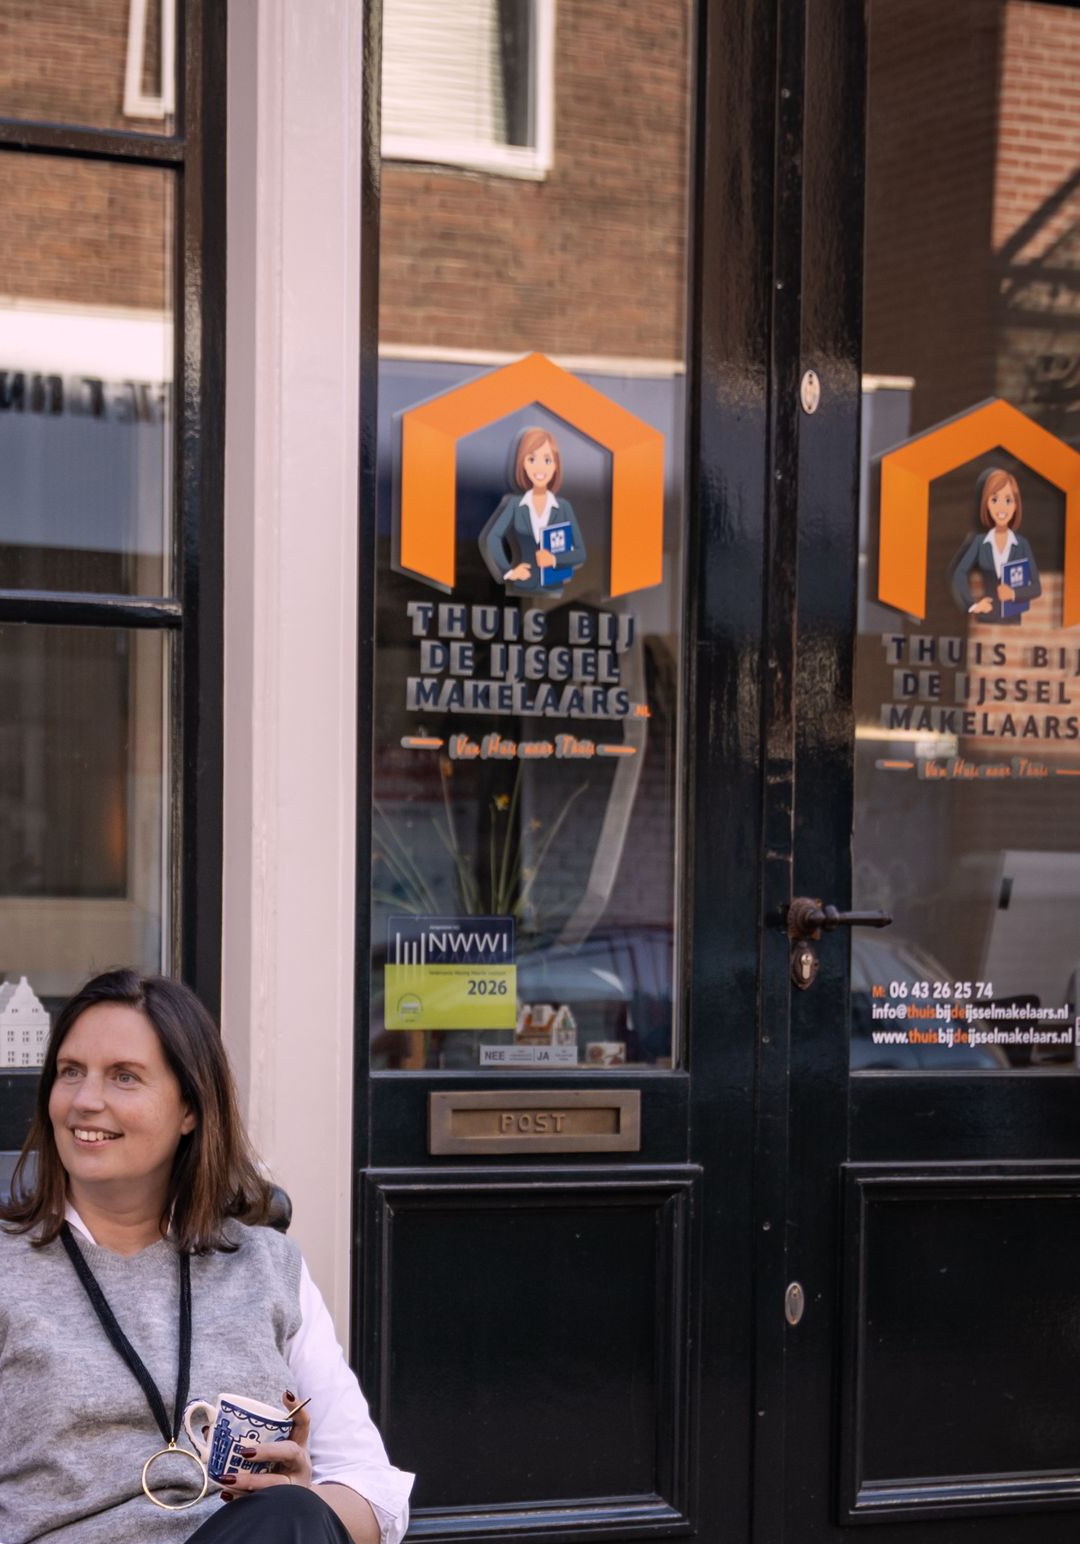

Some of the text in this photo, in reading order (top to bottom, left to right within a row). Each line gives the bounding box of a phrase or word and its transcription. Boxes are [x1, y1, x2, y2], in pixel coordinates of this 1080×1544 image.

[414, 604, 635, 650] THUIS BIJ
[891, 636, 1007, 667] THUIS
[427, 642, 620, 683] DE IJSSEL
[902, 673, 1072, 706] DE IJSSEL
[888, 706, 1080, 740] MAKELAARS
[428, 932, 508, 953] NWWI
[467, 979, 508, 996] 2026
[889, 981, 908, 999] 06
[910, 982, 930, 999] 43
[932, 982, 952, 999] 26
[953, 983, 972, 999] 25
[975, 983, 994, 999] 74
[872, 1003, 1069, 1023] info@thuisbijdeijsselmakelaars.nl
[872, 1027, 1073, 1048] www.thuisbijdeijsselmakelaars.nl
[484, 1050, 506, 1061] NEE
[536, 1051, 550, 1061] JA
[499, 1112, 566, 1134] POST
